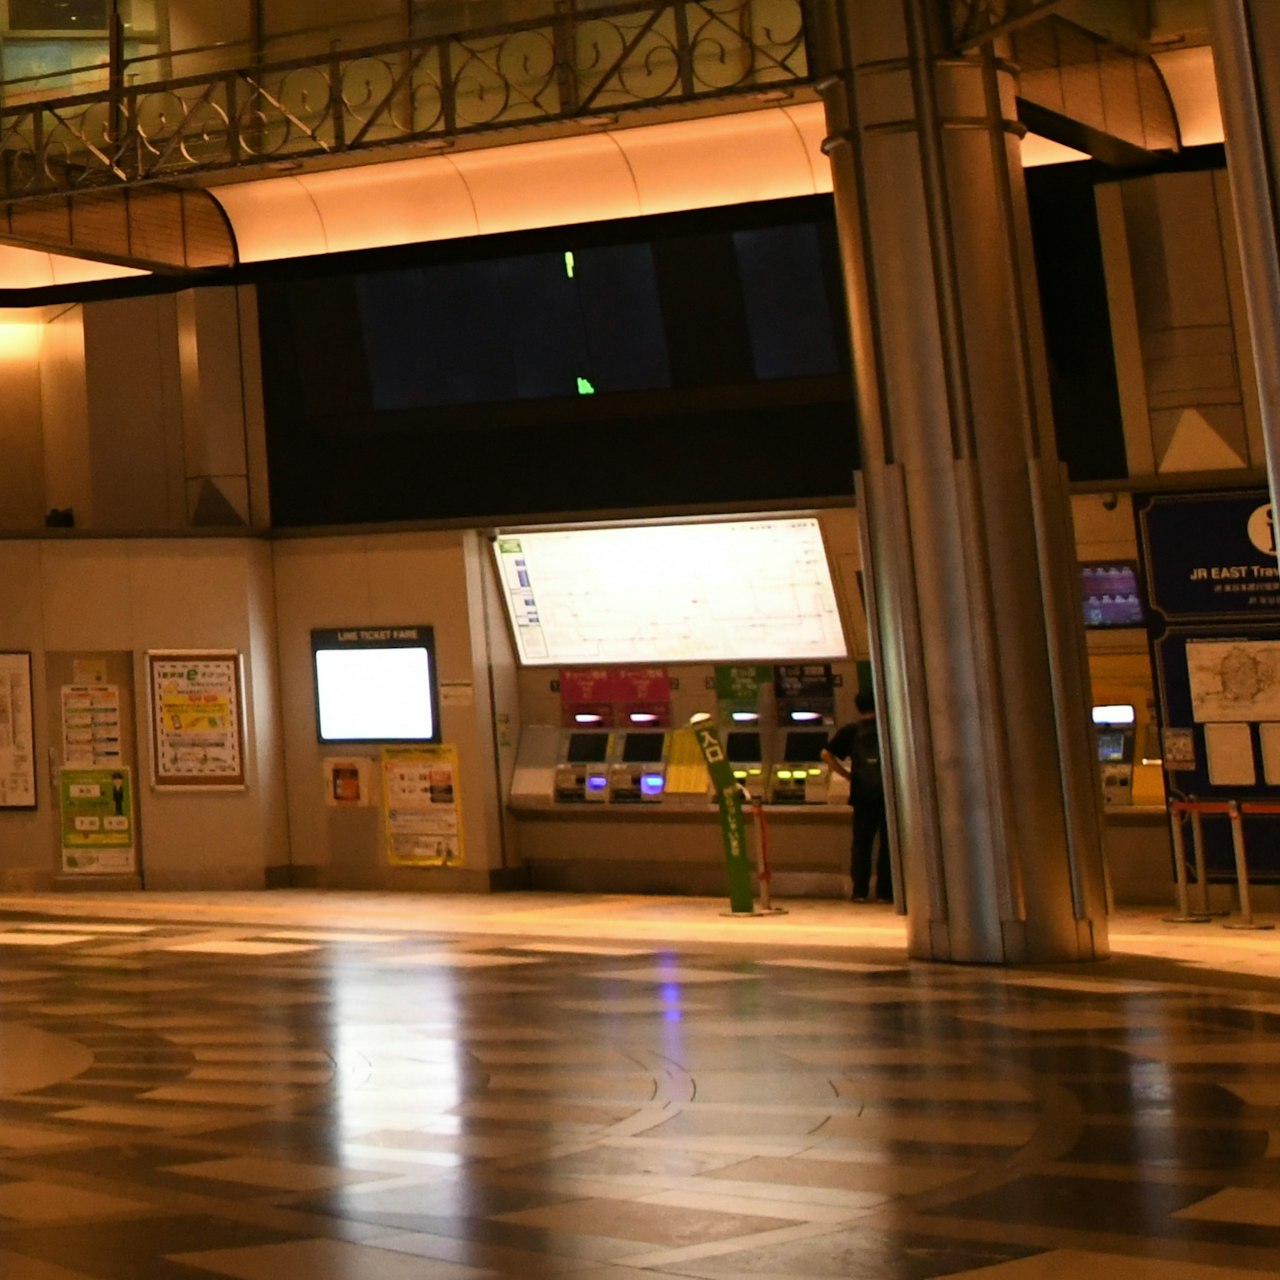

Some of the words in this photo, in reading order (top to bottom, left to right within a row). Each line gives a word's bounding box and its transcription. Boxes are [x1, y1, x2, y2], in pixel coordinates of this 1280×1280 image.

[1189, 568, 1208, 580] JR
[1211, 566, 1248, 580] EAST
[360, 630, 391, 641] TICKET
[700, 730, 725, 763] 入口
